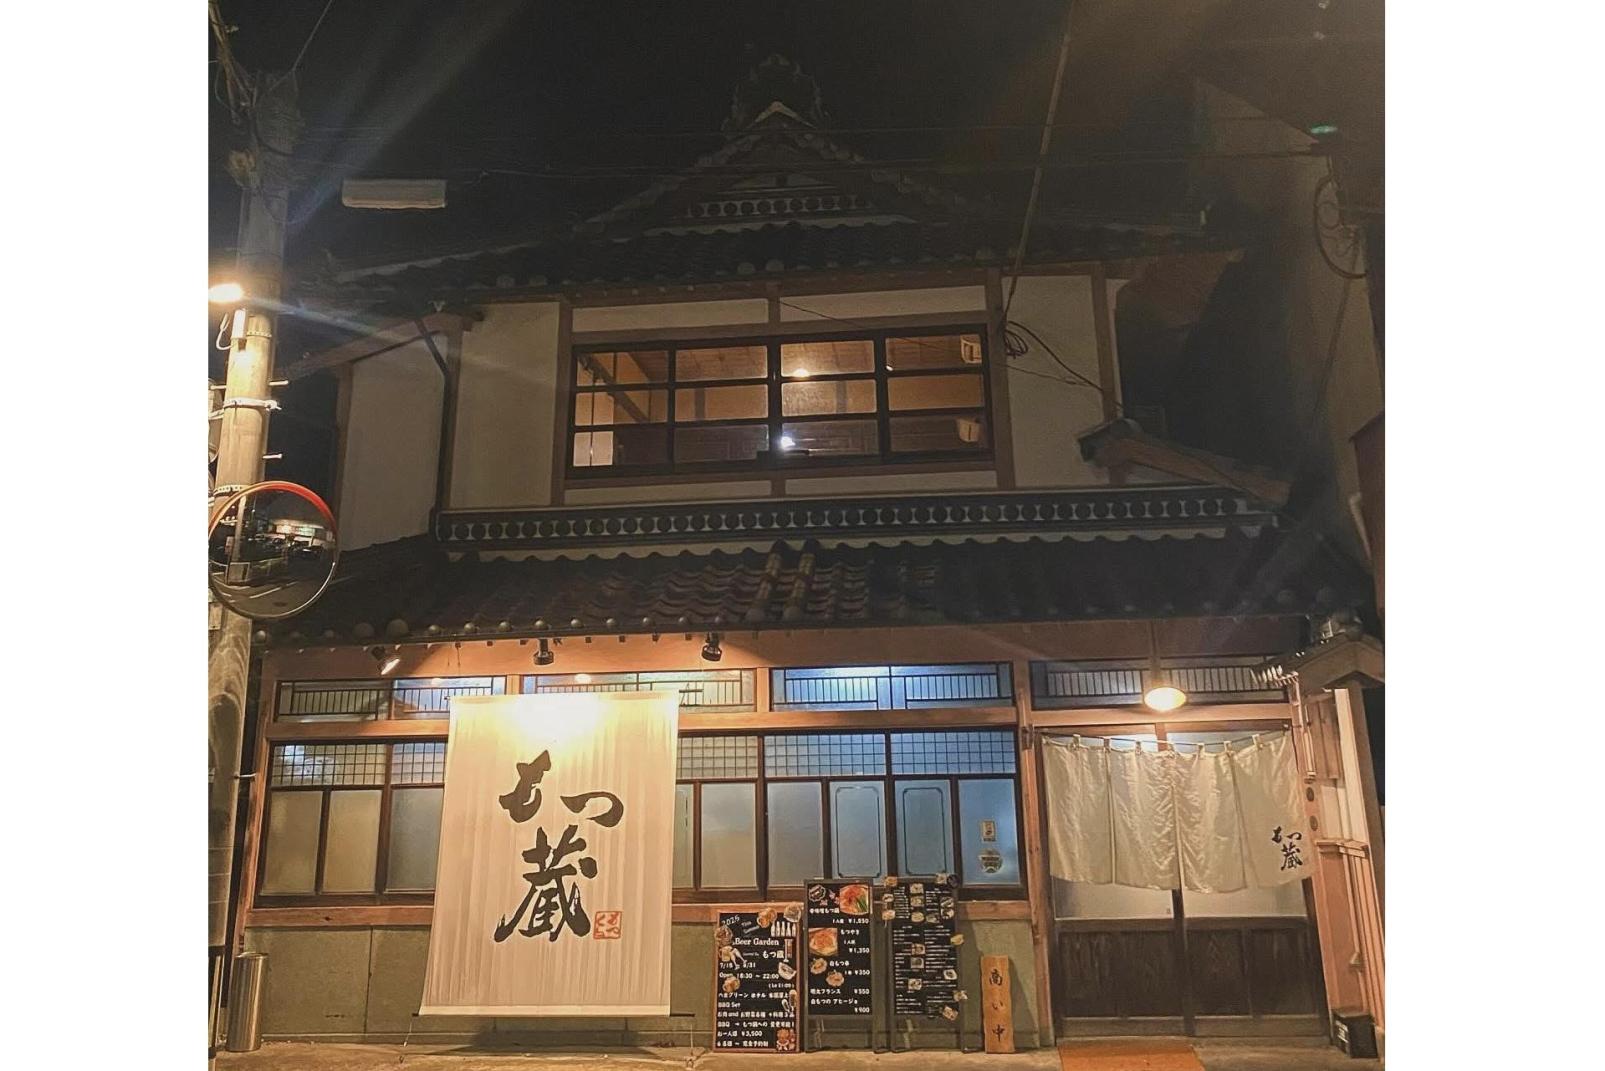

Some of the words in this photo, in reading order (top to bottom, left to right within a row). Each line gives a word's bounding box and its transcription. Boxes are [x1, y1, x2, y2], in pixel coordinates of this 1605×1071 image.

[499, 750, 624, 828] もつ
[1272, 826, 1302, 843] もつ
[1280, 842, 1303, 870] 蔵
[494, 825, 598, 942] 蔵
[734, 937, 752, 946] Beer
[753, 937, 780, 946] Garden
